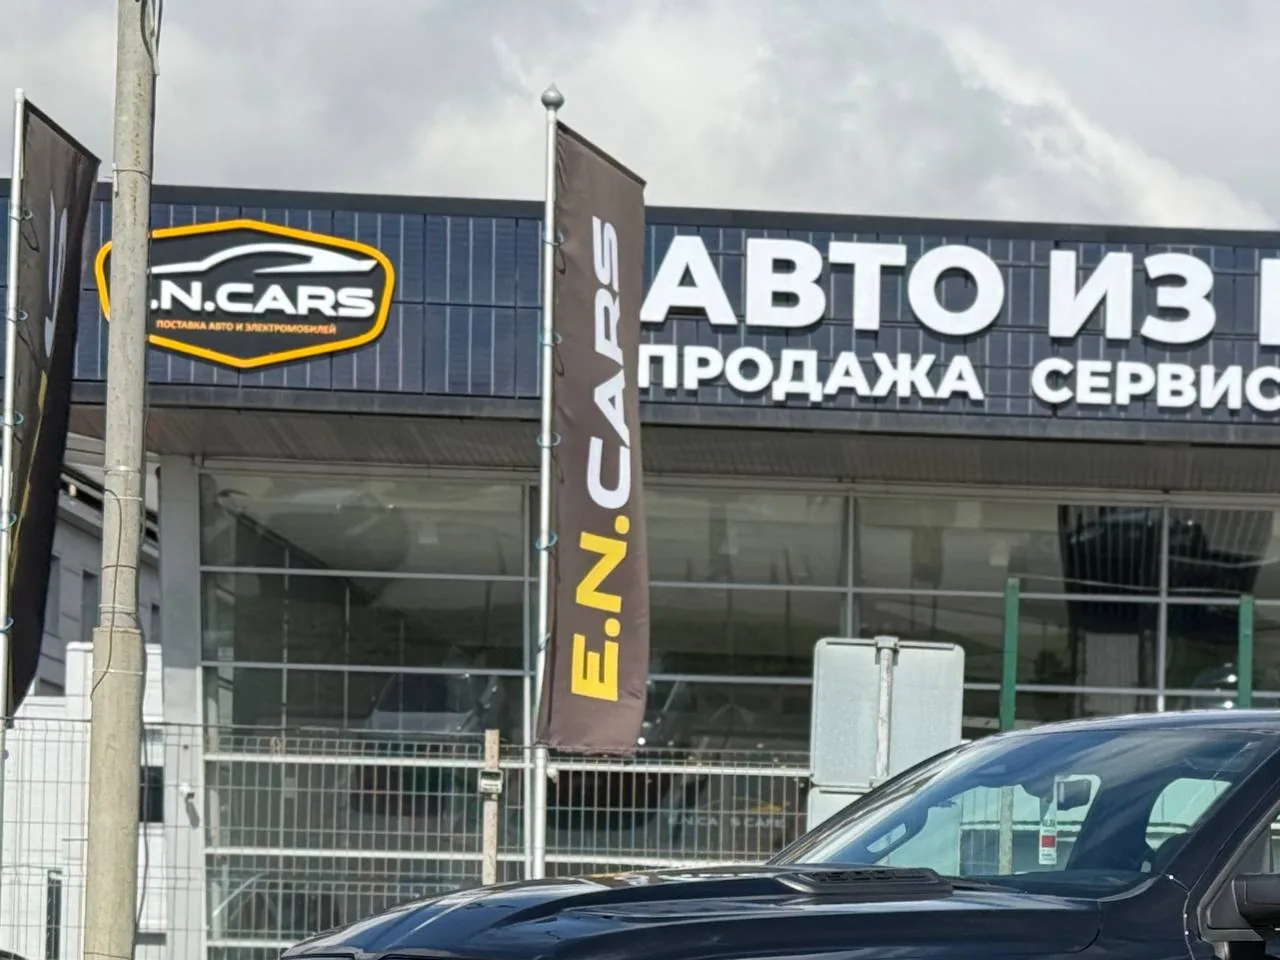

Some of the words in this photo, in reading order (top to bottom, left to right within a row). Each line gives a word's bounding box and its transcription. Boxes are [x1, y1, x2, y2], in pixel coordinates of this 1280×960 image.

[150, 279, 375, 318] .N.CARS
[640, 235, 1004, 336] АВТО
[1048, 250, 1216, 343] ИЗ
[156, 319, 206, 331] ПОСТАВКА
[208, 321, 233, 332] АВТО
[235, 322, 243, 332] И
[244, 322, 336, 335] ЭЛЕКТРОМОБИЛЕЙ
[638, 344, 984, 401] ПРОДАЖА
[571, 215, 631, 702] E.N.CARS
